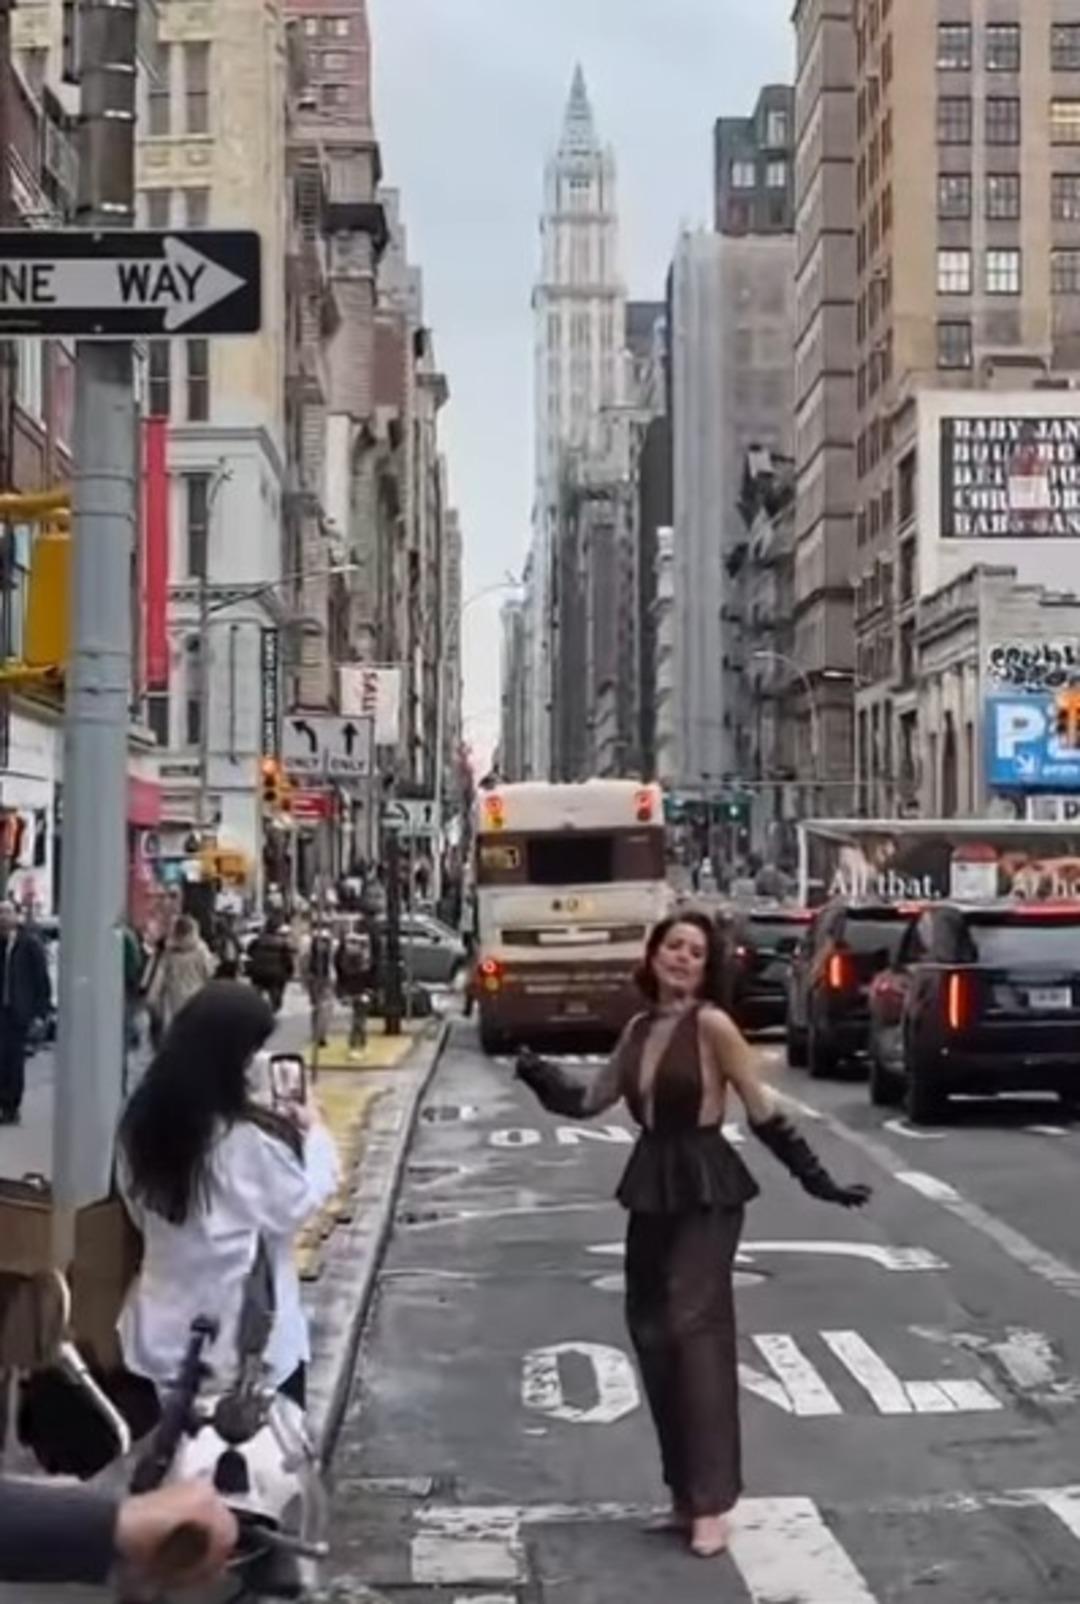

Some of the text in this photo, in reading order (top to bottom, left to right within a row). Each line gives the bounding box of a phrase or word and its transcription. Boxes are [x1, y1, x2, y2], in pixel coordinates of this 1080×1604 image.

[117, 263, 207, 303] WAY
[954, 420, 1022, 440] BABY
[827, 867, 867, 897] All
[877, 869, 941, 897] that.
